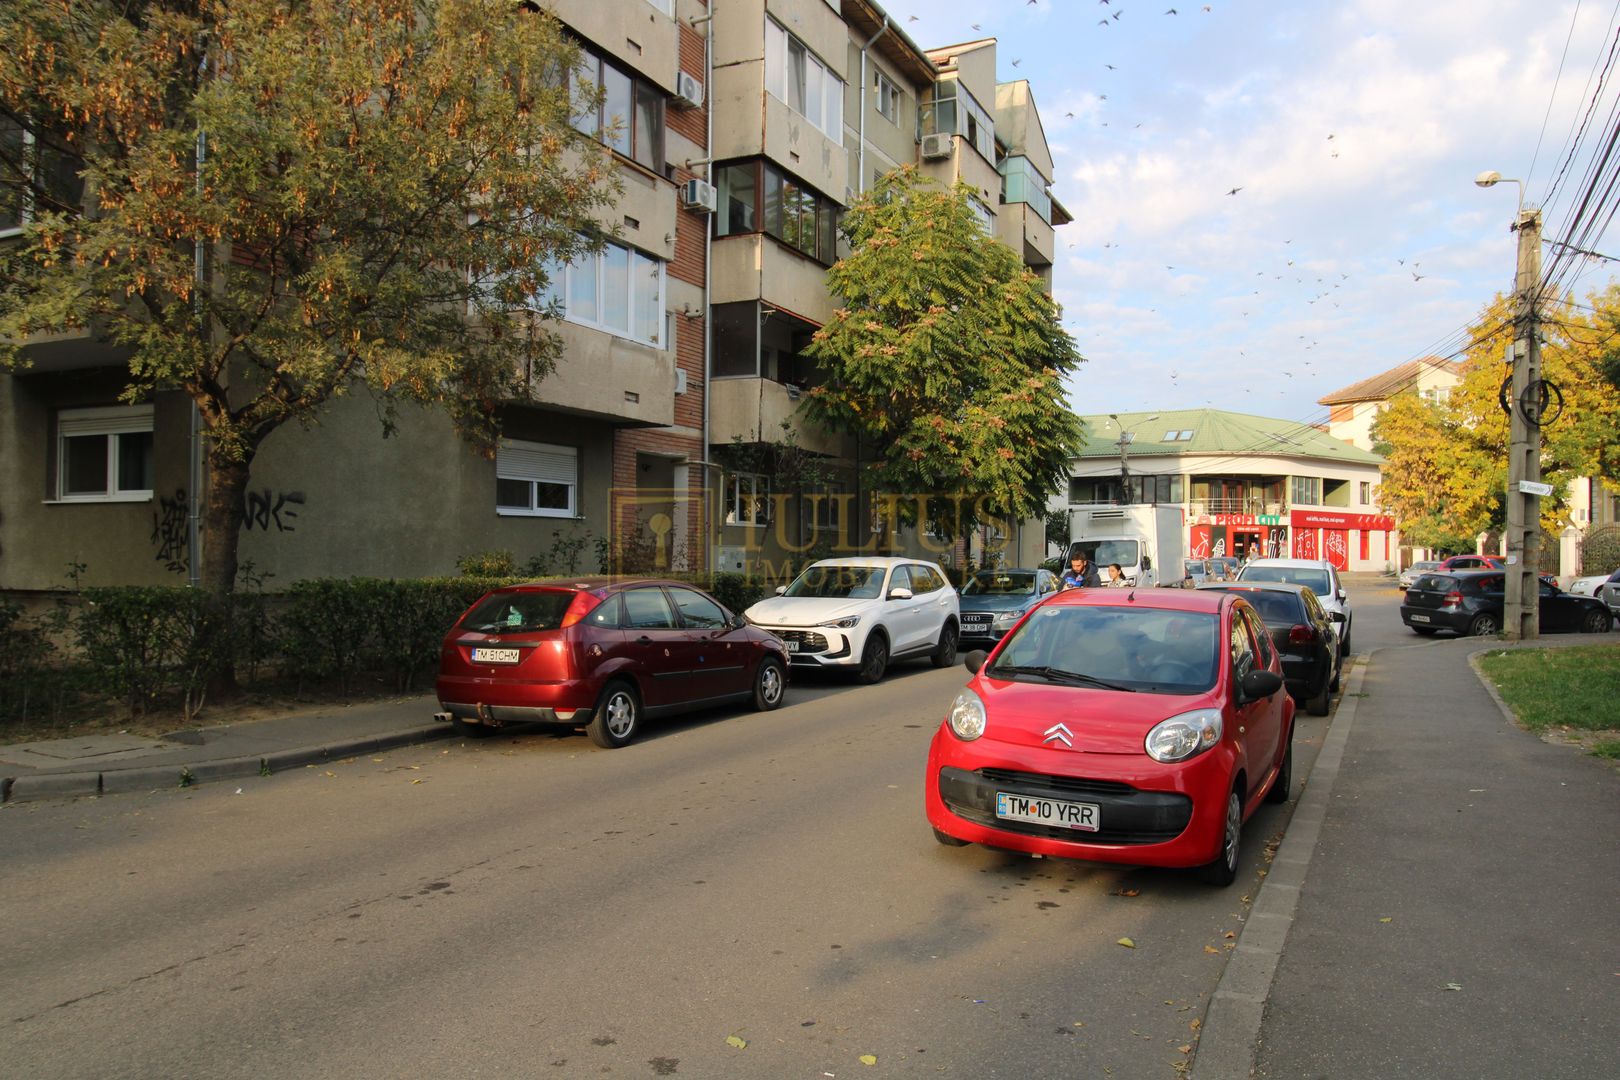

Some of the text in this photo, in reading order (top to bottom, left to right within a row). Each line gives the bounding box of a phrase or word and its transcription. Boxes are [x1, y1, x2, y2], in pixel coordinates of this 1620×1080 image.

[1216, 514, 1280, 525] PROFI CITY
[1057, 804, 1093, 825] YRR
